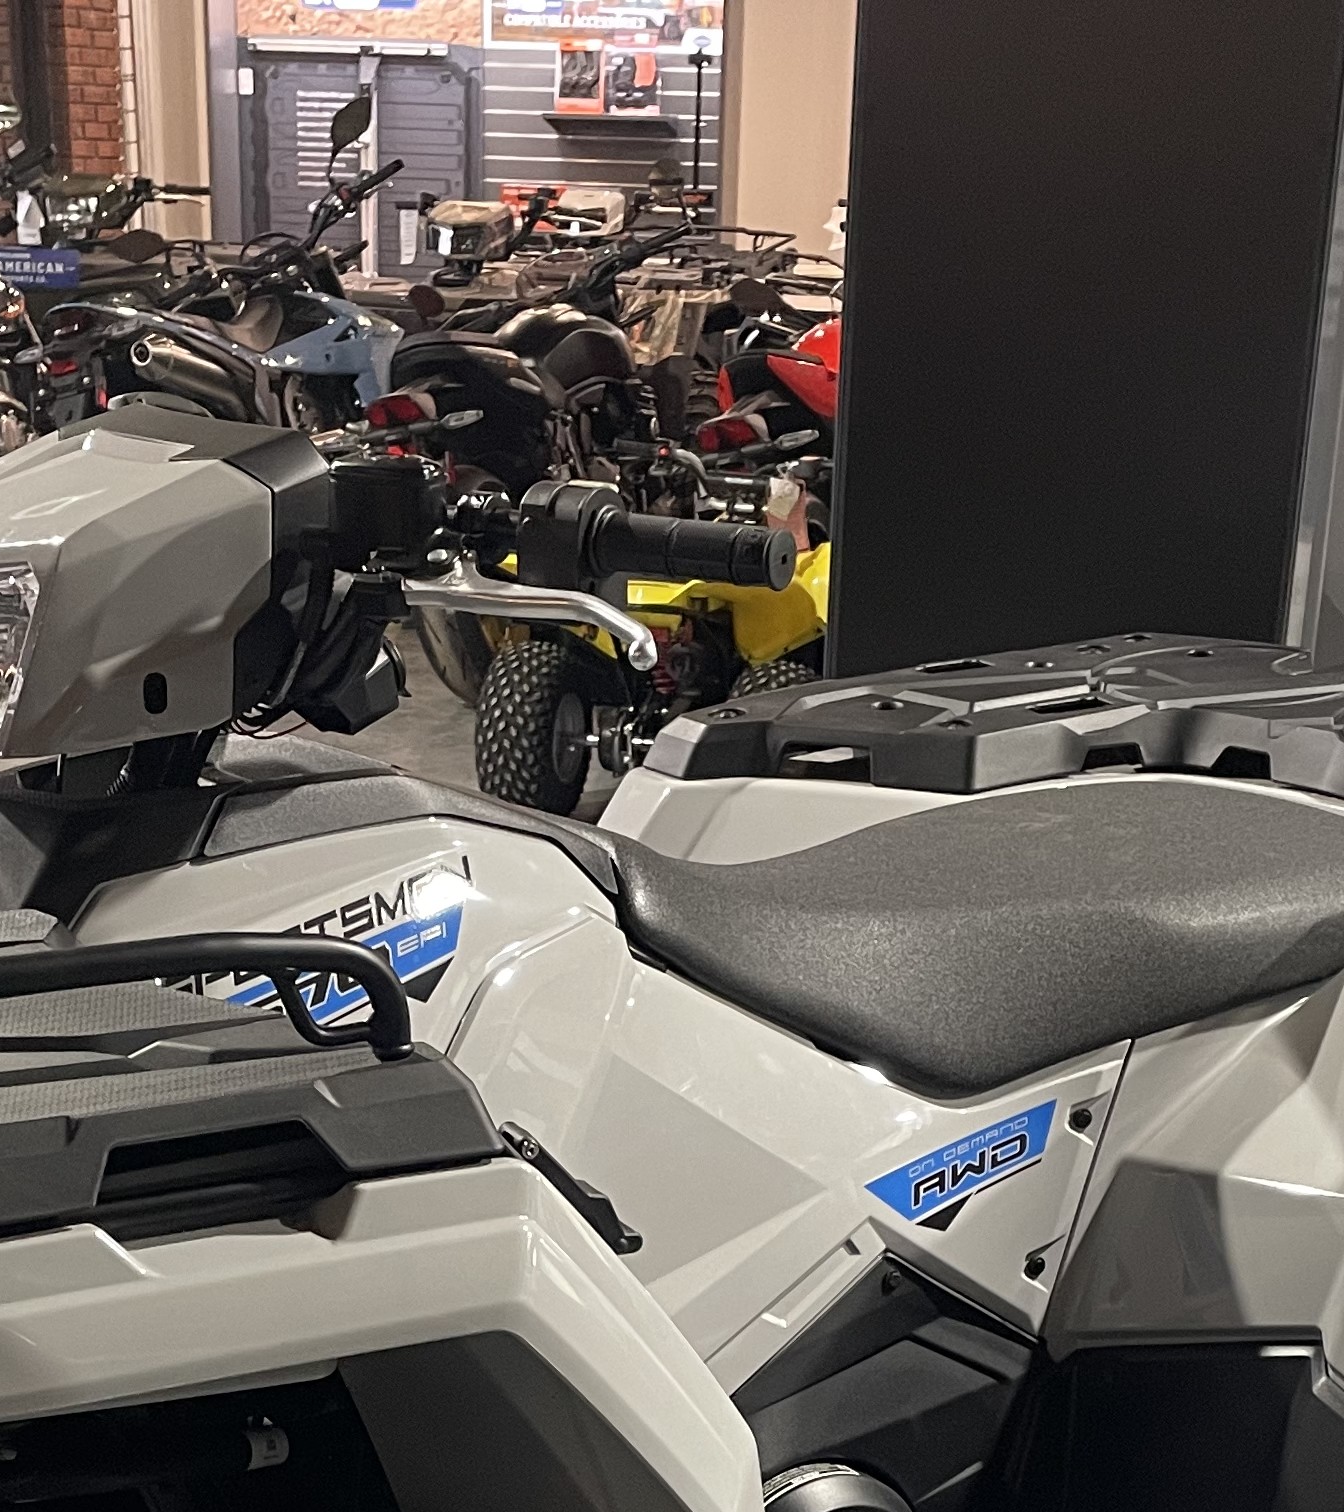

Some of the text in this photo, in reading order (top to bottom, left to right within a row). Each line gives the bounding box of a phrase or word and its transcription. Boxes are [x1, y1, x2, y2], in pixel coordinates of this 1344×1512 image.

[908, 1116, 1029, 1178] ON DEMAND
[911, 1130, 1030, 1211] AWD
